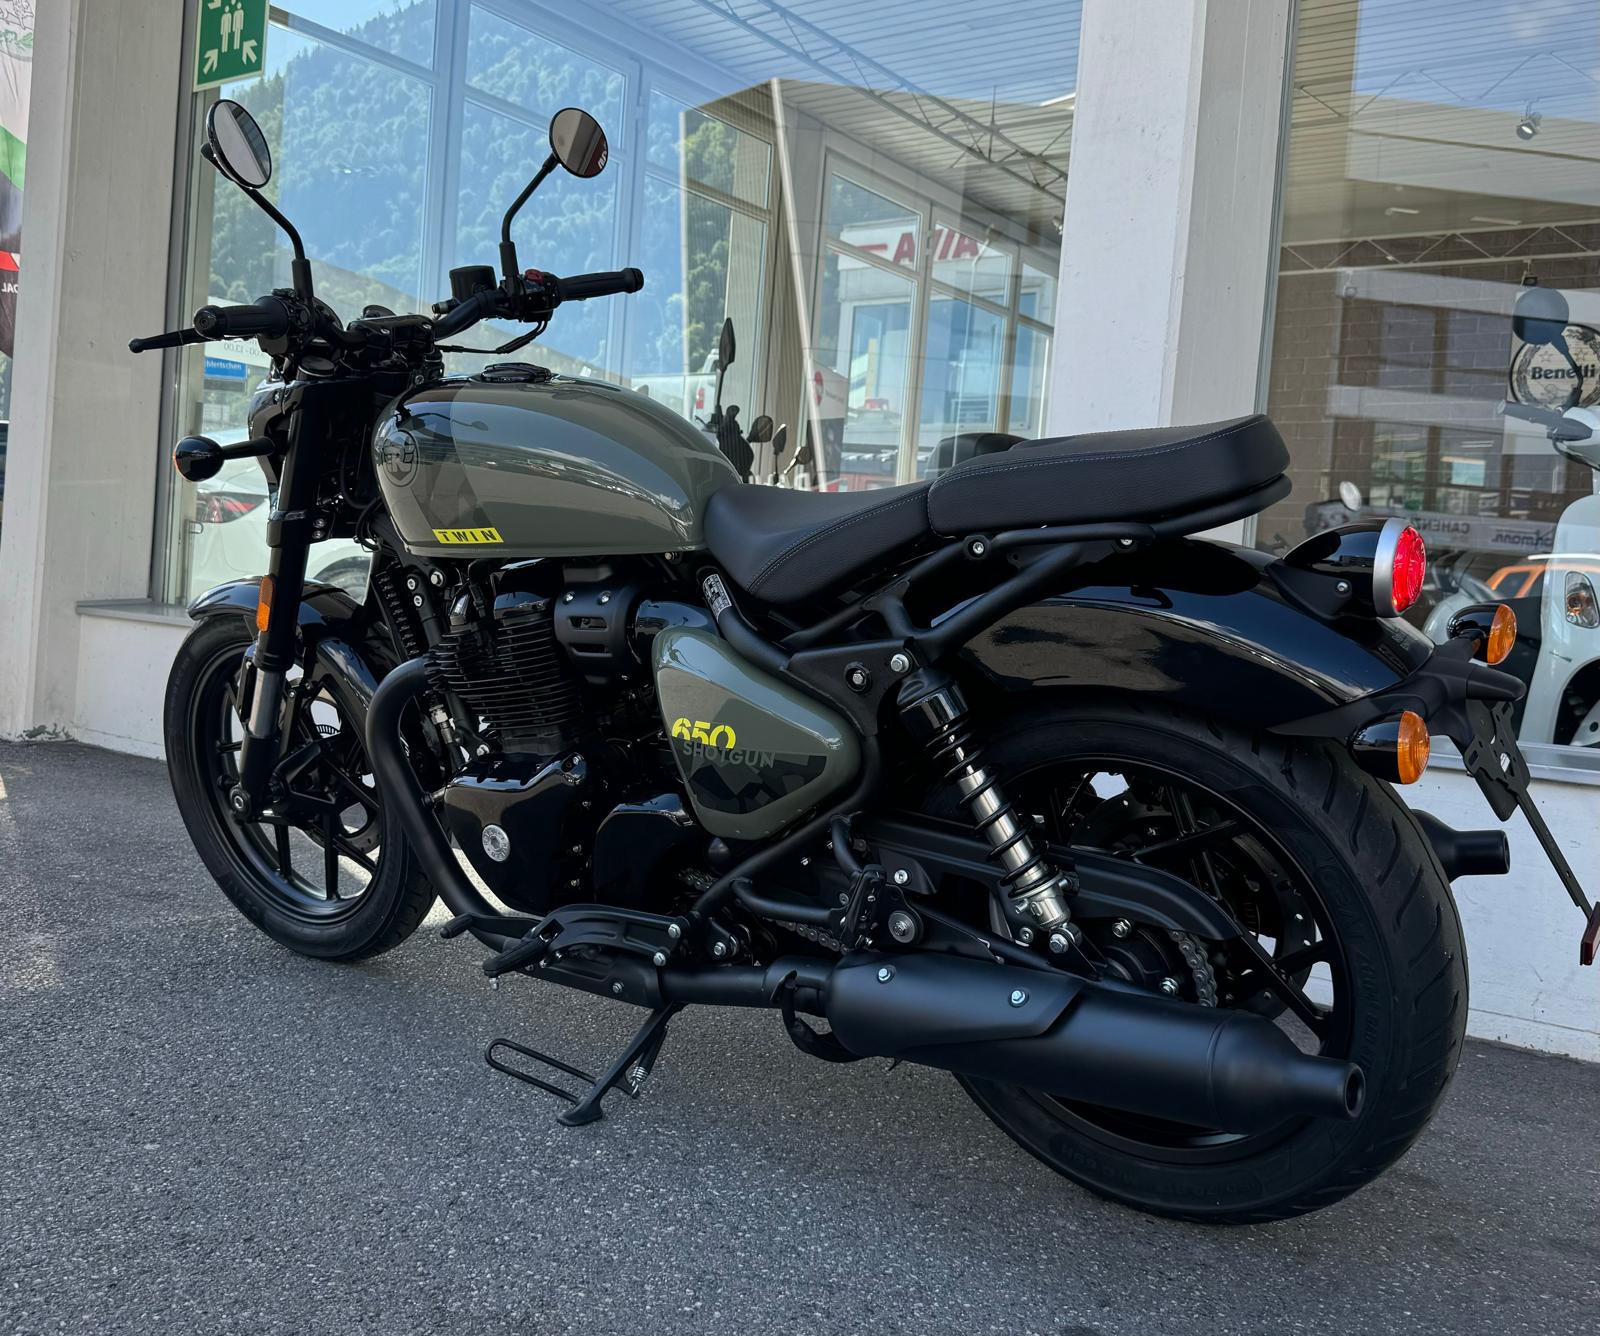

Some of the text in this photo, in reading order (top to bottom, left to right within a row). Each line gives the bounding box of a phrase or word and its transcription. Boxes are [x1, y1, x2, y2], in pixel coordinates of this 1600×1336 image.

[1531, 364, 1596, 380] Beneli
[438, 530, 497, 542] TWIN
[671, 717, 736, 749] 650
[683, 741, 776, 769] SHOTGUN
